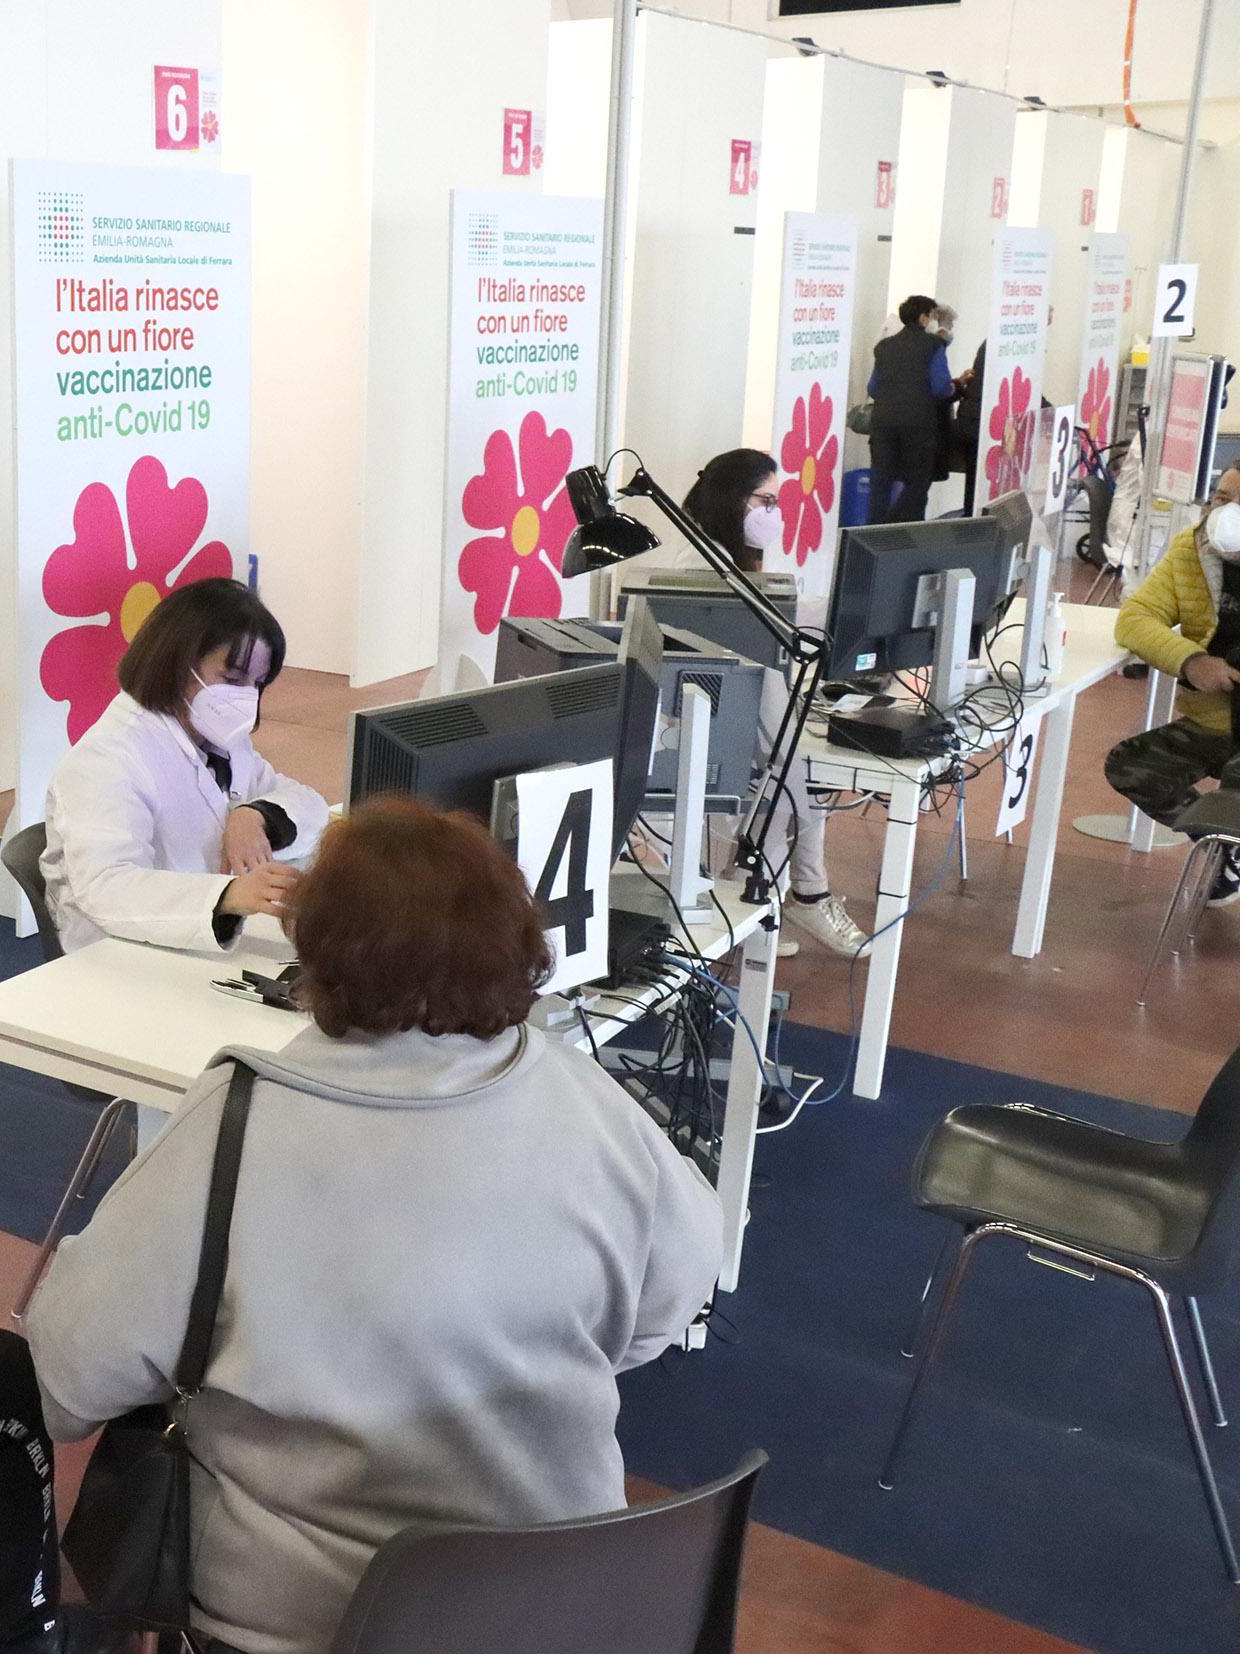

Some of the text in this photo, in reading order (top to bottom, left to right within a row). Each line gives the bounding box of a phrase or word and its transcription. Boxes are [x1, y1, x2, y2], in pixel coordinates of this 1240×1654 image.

[167, 84, 188, 142] 6
[510, 123, 524, 170] 5
[734, 152, 746, 190] 4
[92, 217, 231, 233] SERVIZIO SANITARIO REGIONALE
[92, 234, 173, 248] EMILIA-ROMAGNA
[93, 254, 232, 265] Azienda Unità Sanitaria Locale di Ferrara
[56, 278, 219, 312] l'Italia rinasce
[478, 277, 585, 302] l'Italia rinasce
[1162, 279, 1187, 323] 2
[56, 319, 194, 355] con un fiore
[477, 308, 568, 334] con un fiore
[476, 338, 579, 364] vaccinazione
[56, 358, 212, 396] vaccinazione
[475, 369, 578, 399] anti-Covid 19
[57, 400, 210, 441] anti-Covid 19
[1052, 416, 1070, 498] 3
[1008, 734, 1033, 809] 3
[533, 788, 594, 957] 4
